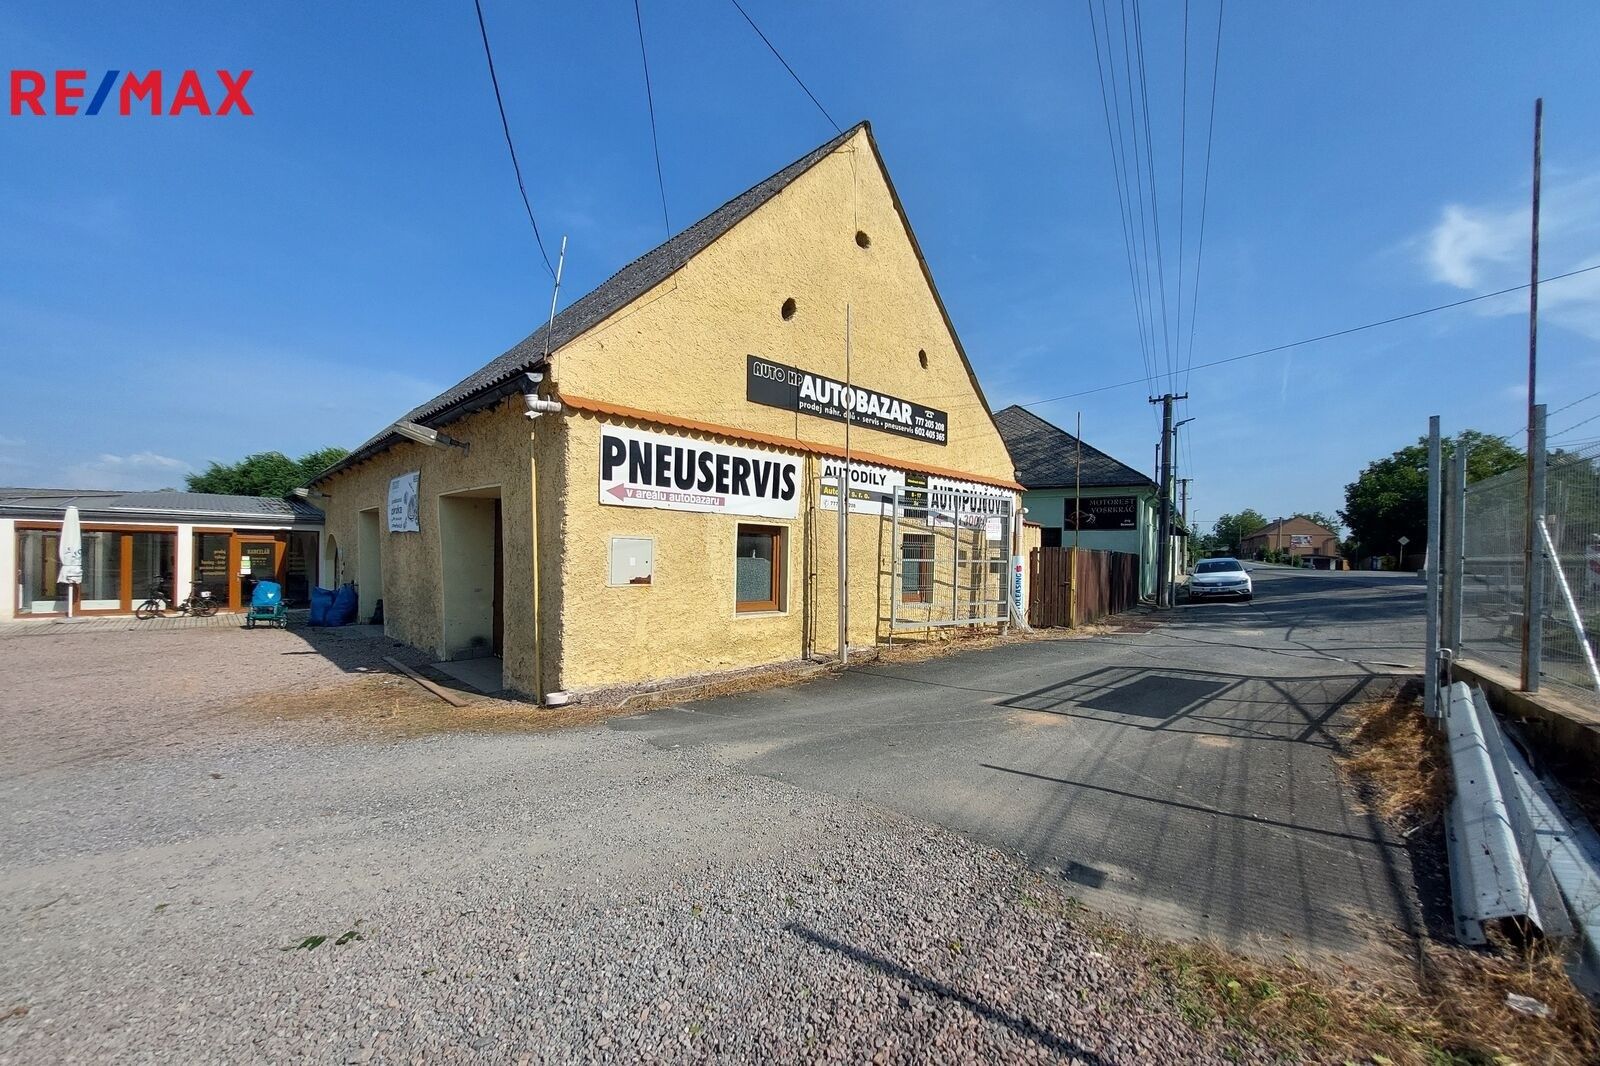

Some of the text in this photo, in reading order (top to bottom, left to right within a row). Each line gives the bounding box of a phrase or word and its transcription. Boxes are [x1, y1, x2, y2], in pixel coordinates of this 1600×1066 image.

[753, 361, 785, 383] AUTO
[799, 374, 913, 426] AUTOBAZAR
[798, 400, 823, 415] prodej
[824, 405, 842, 418] náhr.
[862, 416, 880, 427] servis
[884, 420, 914, 434] pneuservis
[914, 415, 945, 432] 777 205 208
[914, 426, 945, 442] 602 405 365
[602, 434, 796, 501] PNEUSERVIS
[824, 464, 887, 486] AUTODÍLY
[626, 489, 720, 506] v areálu autobazaru
[1089, 498, 1136, 506] MOTOREST
